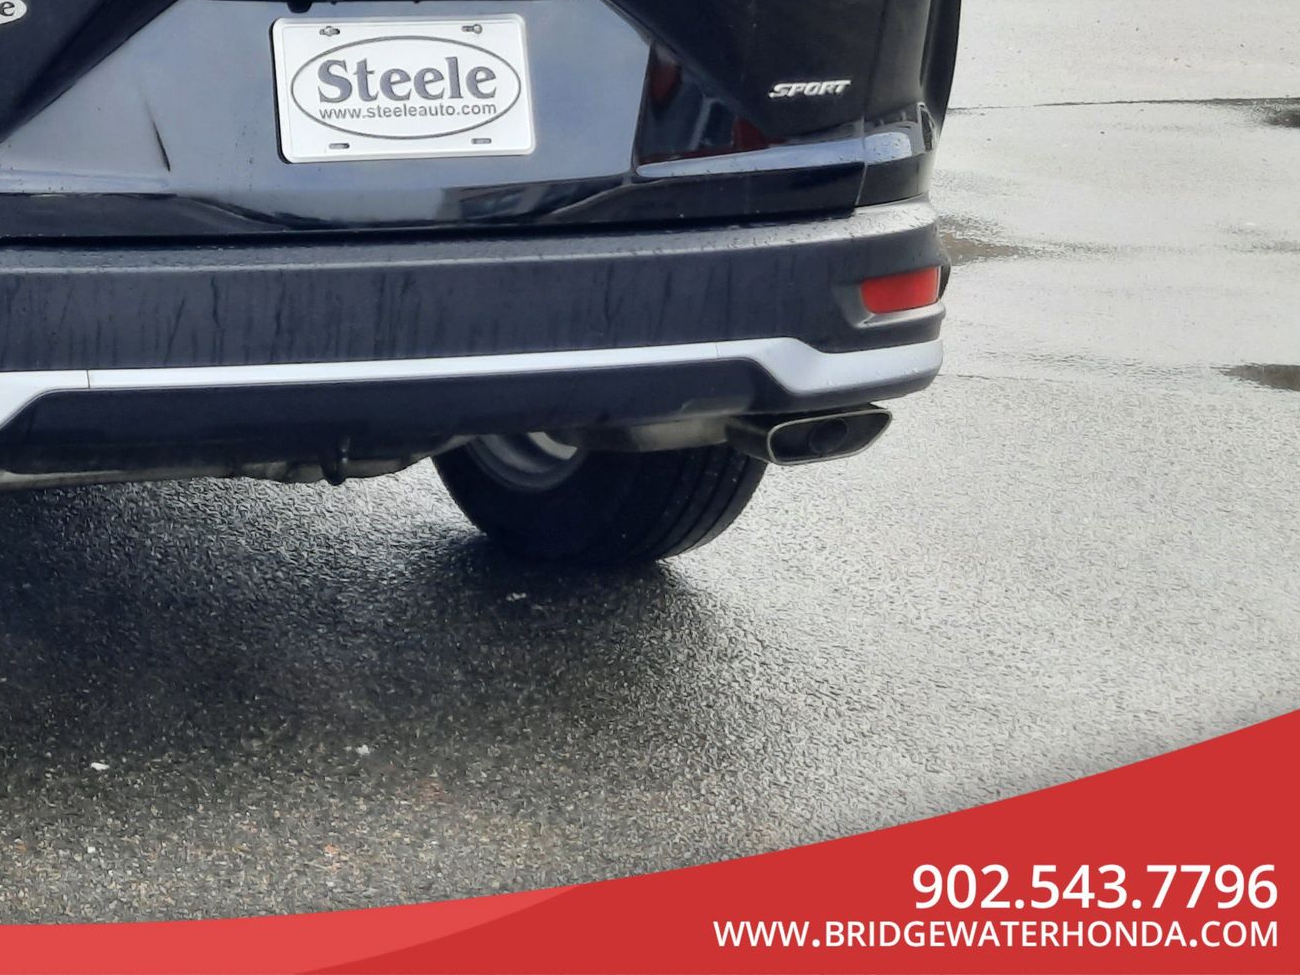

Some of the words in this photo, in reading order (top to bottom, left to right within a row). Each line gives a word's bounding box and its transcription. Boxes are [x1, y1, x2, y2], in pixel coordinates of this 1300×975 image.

[316, 56, 498, 104] Steele
[768, 79, 852, 98] SPORT
[318, 102, 498, 120] www.steeleauto.com
